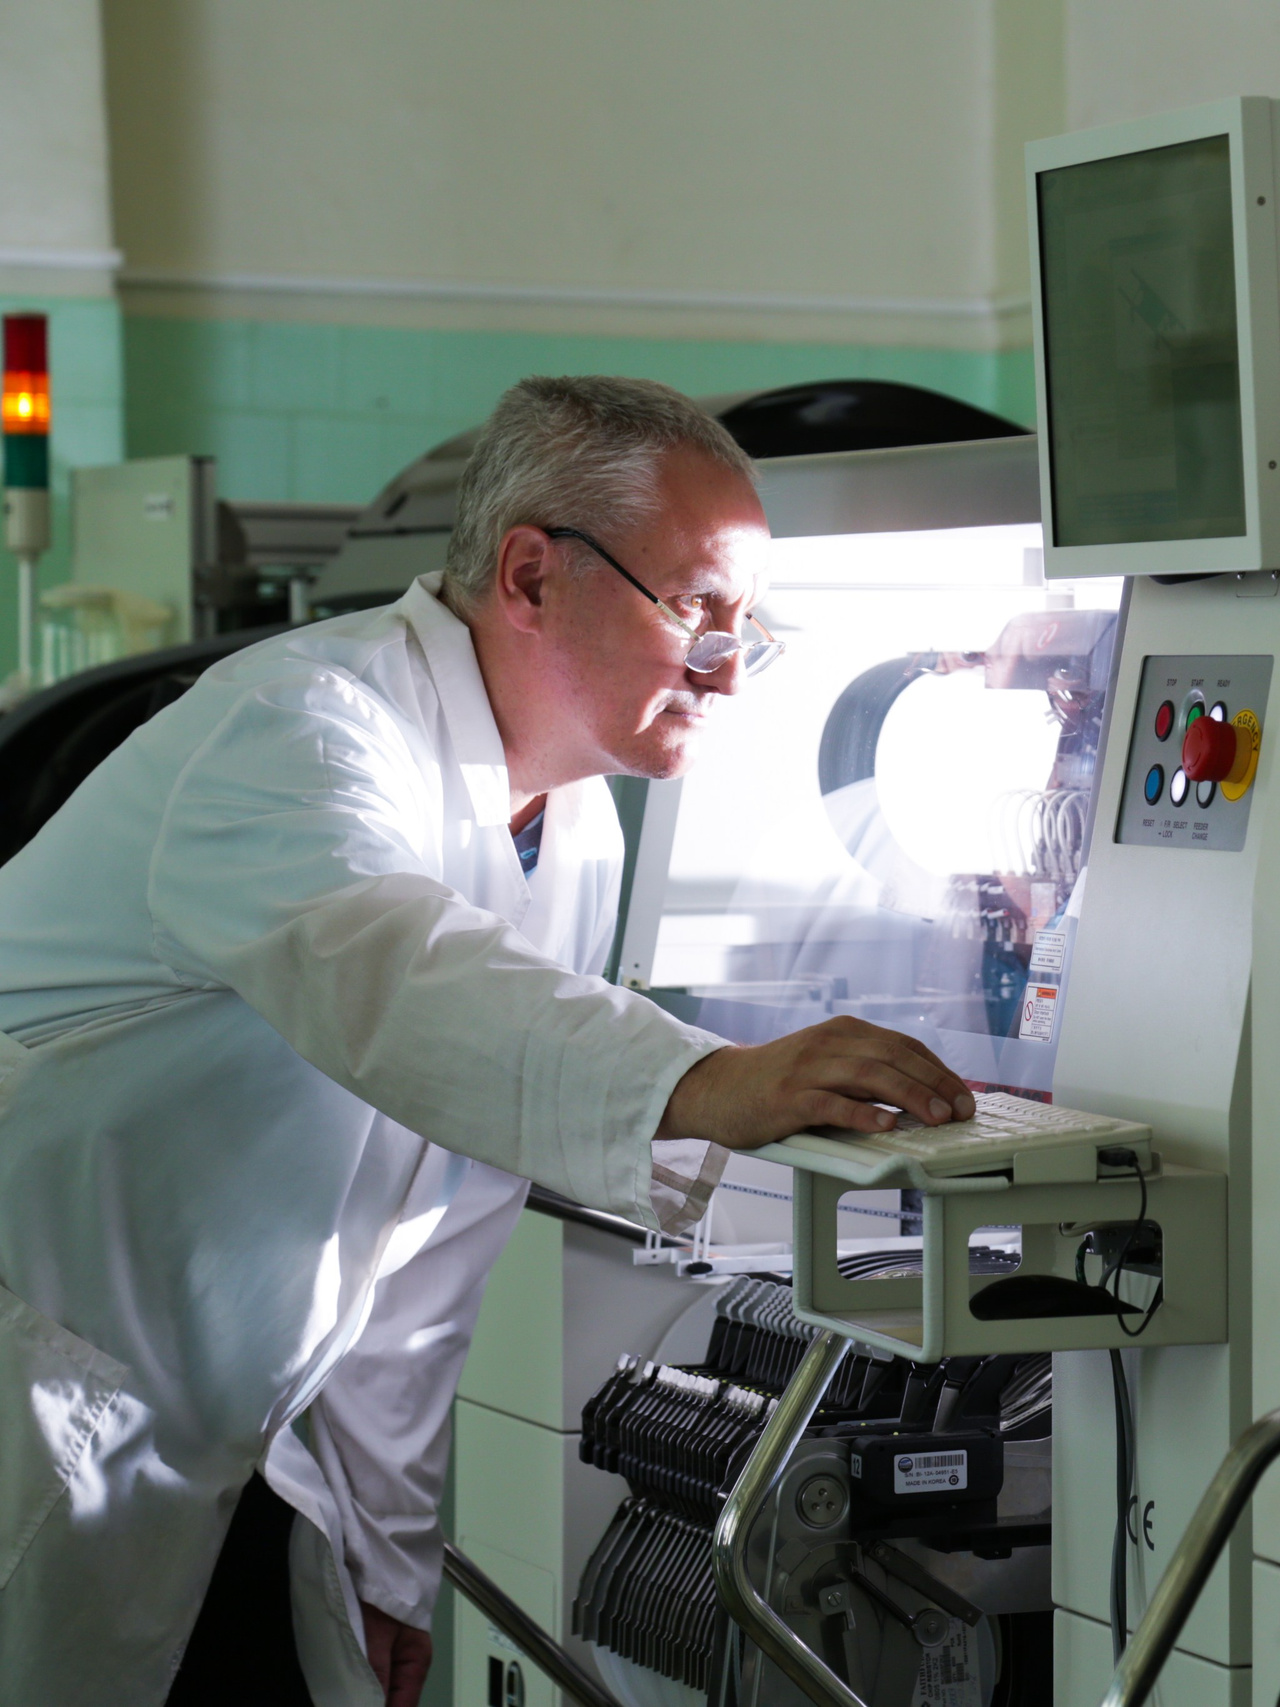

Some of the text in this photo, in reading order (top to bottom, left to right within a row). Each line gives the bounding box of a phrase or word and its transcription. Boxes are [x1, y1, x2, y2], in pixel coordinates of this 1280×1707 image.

[1166, 678, 1177, 687] STOP
[1191, 678, 1204, 687] START
[1216, 679, 1230, 688] READY
[1142, 819, 1155, 827] RESET
[1173, 821, 1188, 829] SELECT
[1162, 830, 1173, 839] LOCK
[1191, 832, 1208, 841] CHANGE
